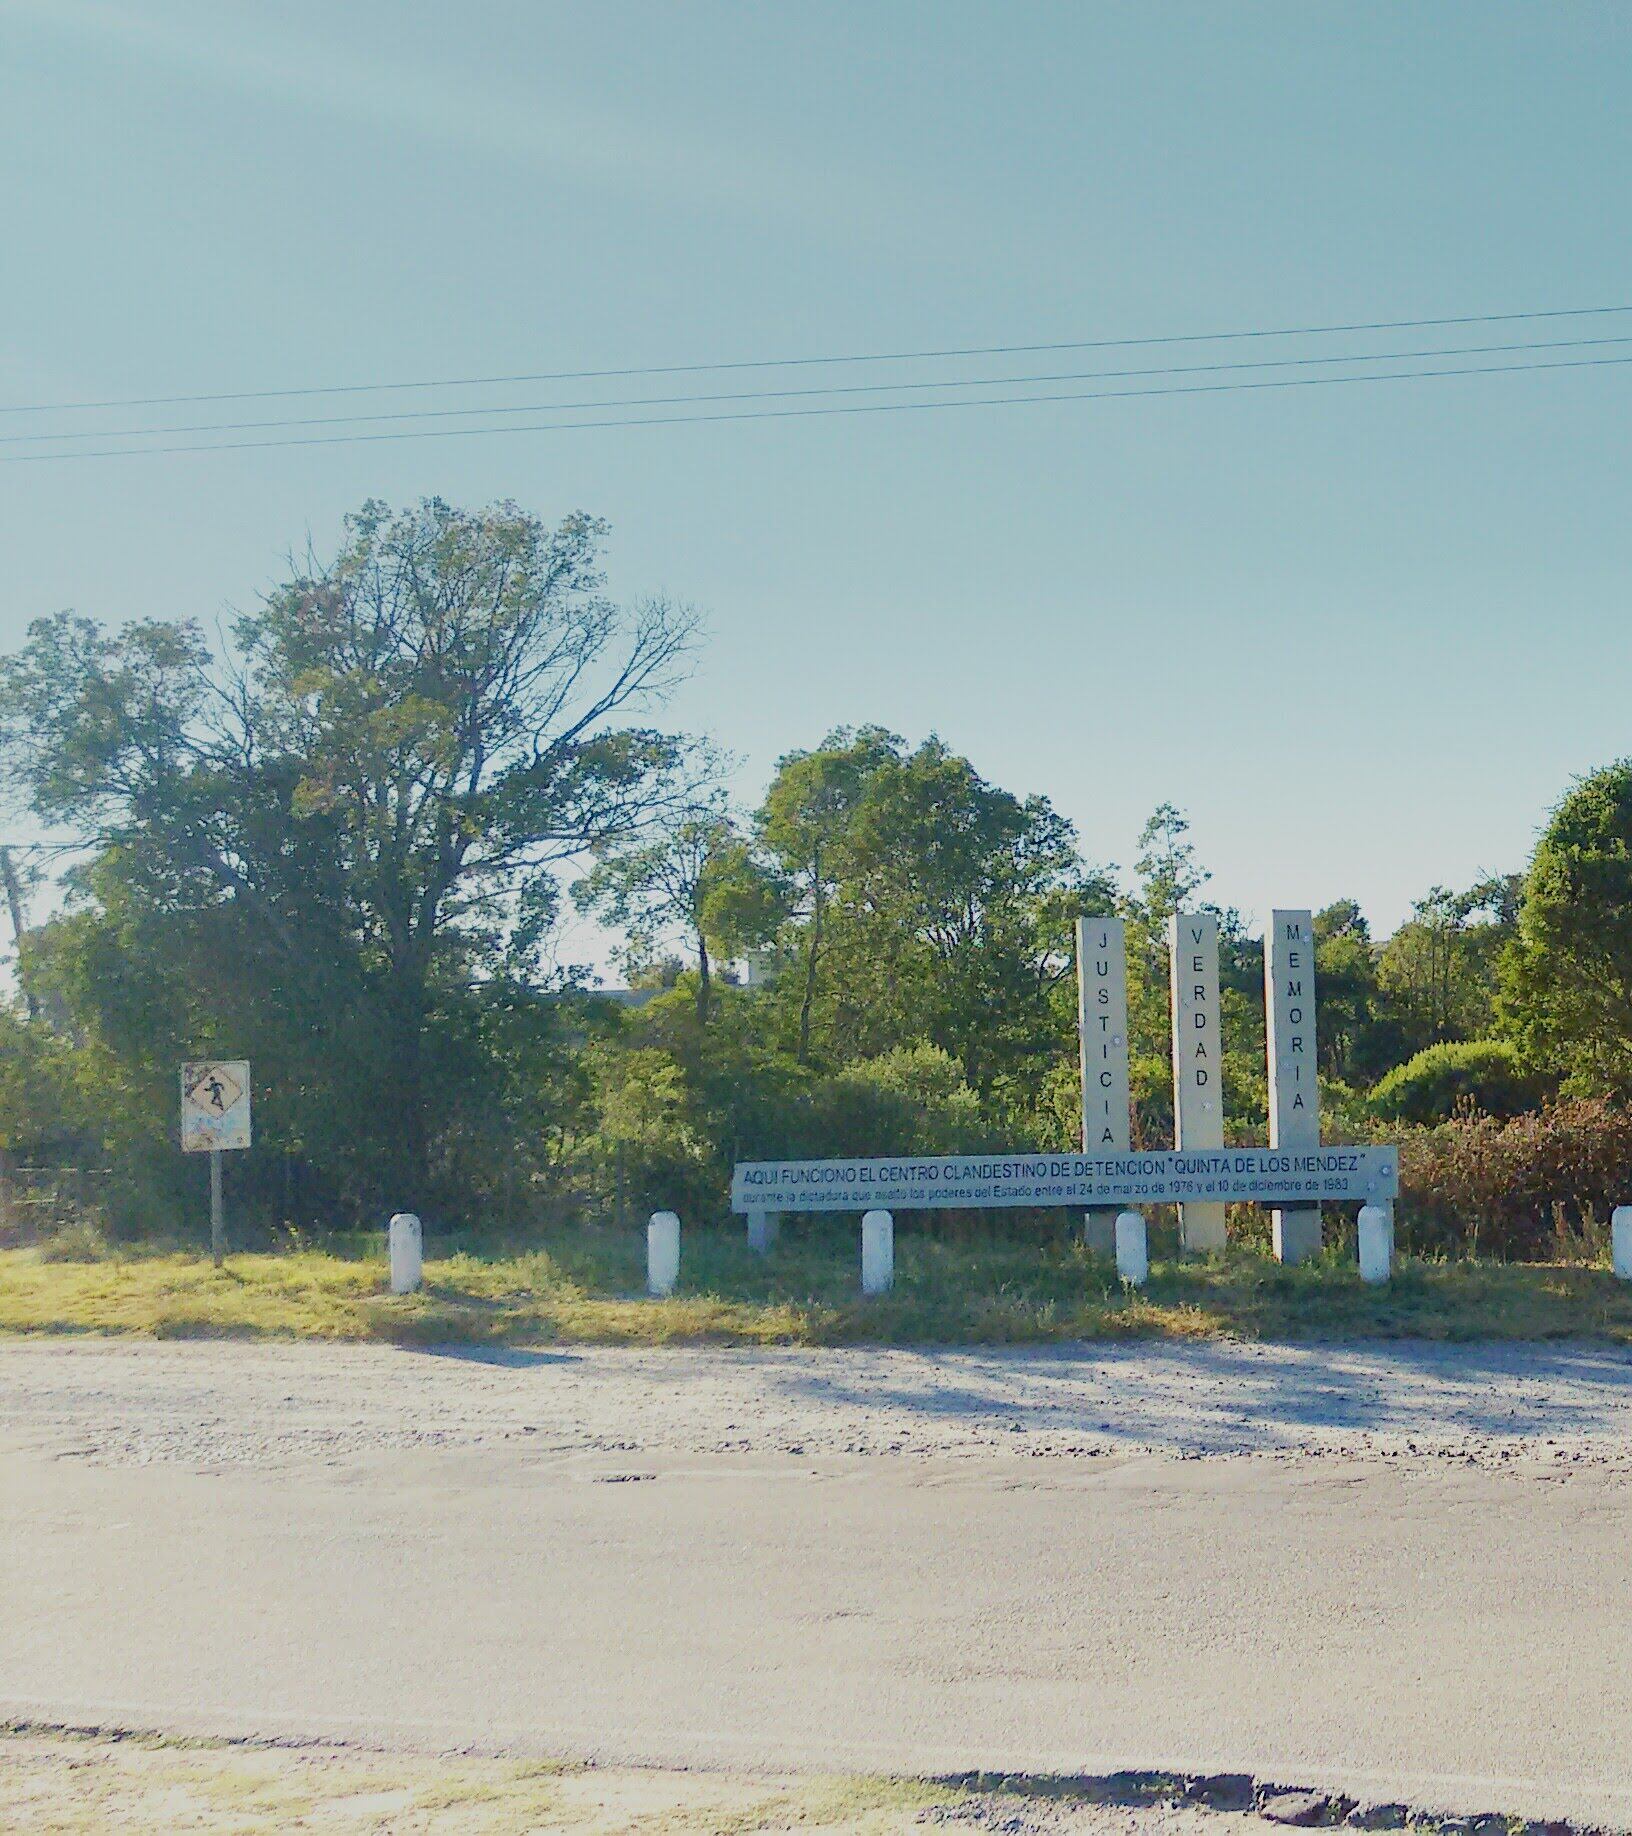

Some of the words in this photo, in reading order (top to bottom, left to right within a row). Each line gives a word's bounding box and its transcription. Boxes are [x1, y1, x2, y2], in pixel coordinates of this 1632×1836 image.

[1096, 932, 1114, 1144] JUSTICIA
[1191, 928, 1208, 1087] VERDAD
[1286, 924, 1304, 1110] MEMORIA
[743, 1169, 778, 1184] AQUI
[781, 1167, 857, 1184] FUNCIONO
[859, 1167, 876, 1182] EL
[879, 1165, 939, 1182] CENTRO
[943, 1162, 1047, 1181] CLANDESTINO
[1051, 1161, 1070, 1177] DE
[1074, 1159, 1165, 1177] DETENCION
[1235, 1157, 1256, 1173] DE
[1260, 1157, 1290, 1173] LOS
[1294, 1153, 1366, 1172] MENDEZ"
[929, 1187, 972, 1201] poderes
[994, 1184, 1031, 1198] Estado
[1035, 1184, 1063, 1196] entre
[1079, 1183, 1093, 1196] 24
[1096, 1181, 1110, 1194] de
[1113, 1182, 1149, 1194] marzo
[1151, 1180, 1165, 1193] de
[1169, 1180, 1194, 1193] 1976
[1205, 1180, 1215, 1192] el
[1218, 1179, 1229, 1191] 10
[1232, 1179, 1247, 1192] de
[1250, 1178, 1301, 1192] diciembre
[1305, 1177, 1319, 1190] de
